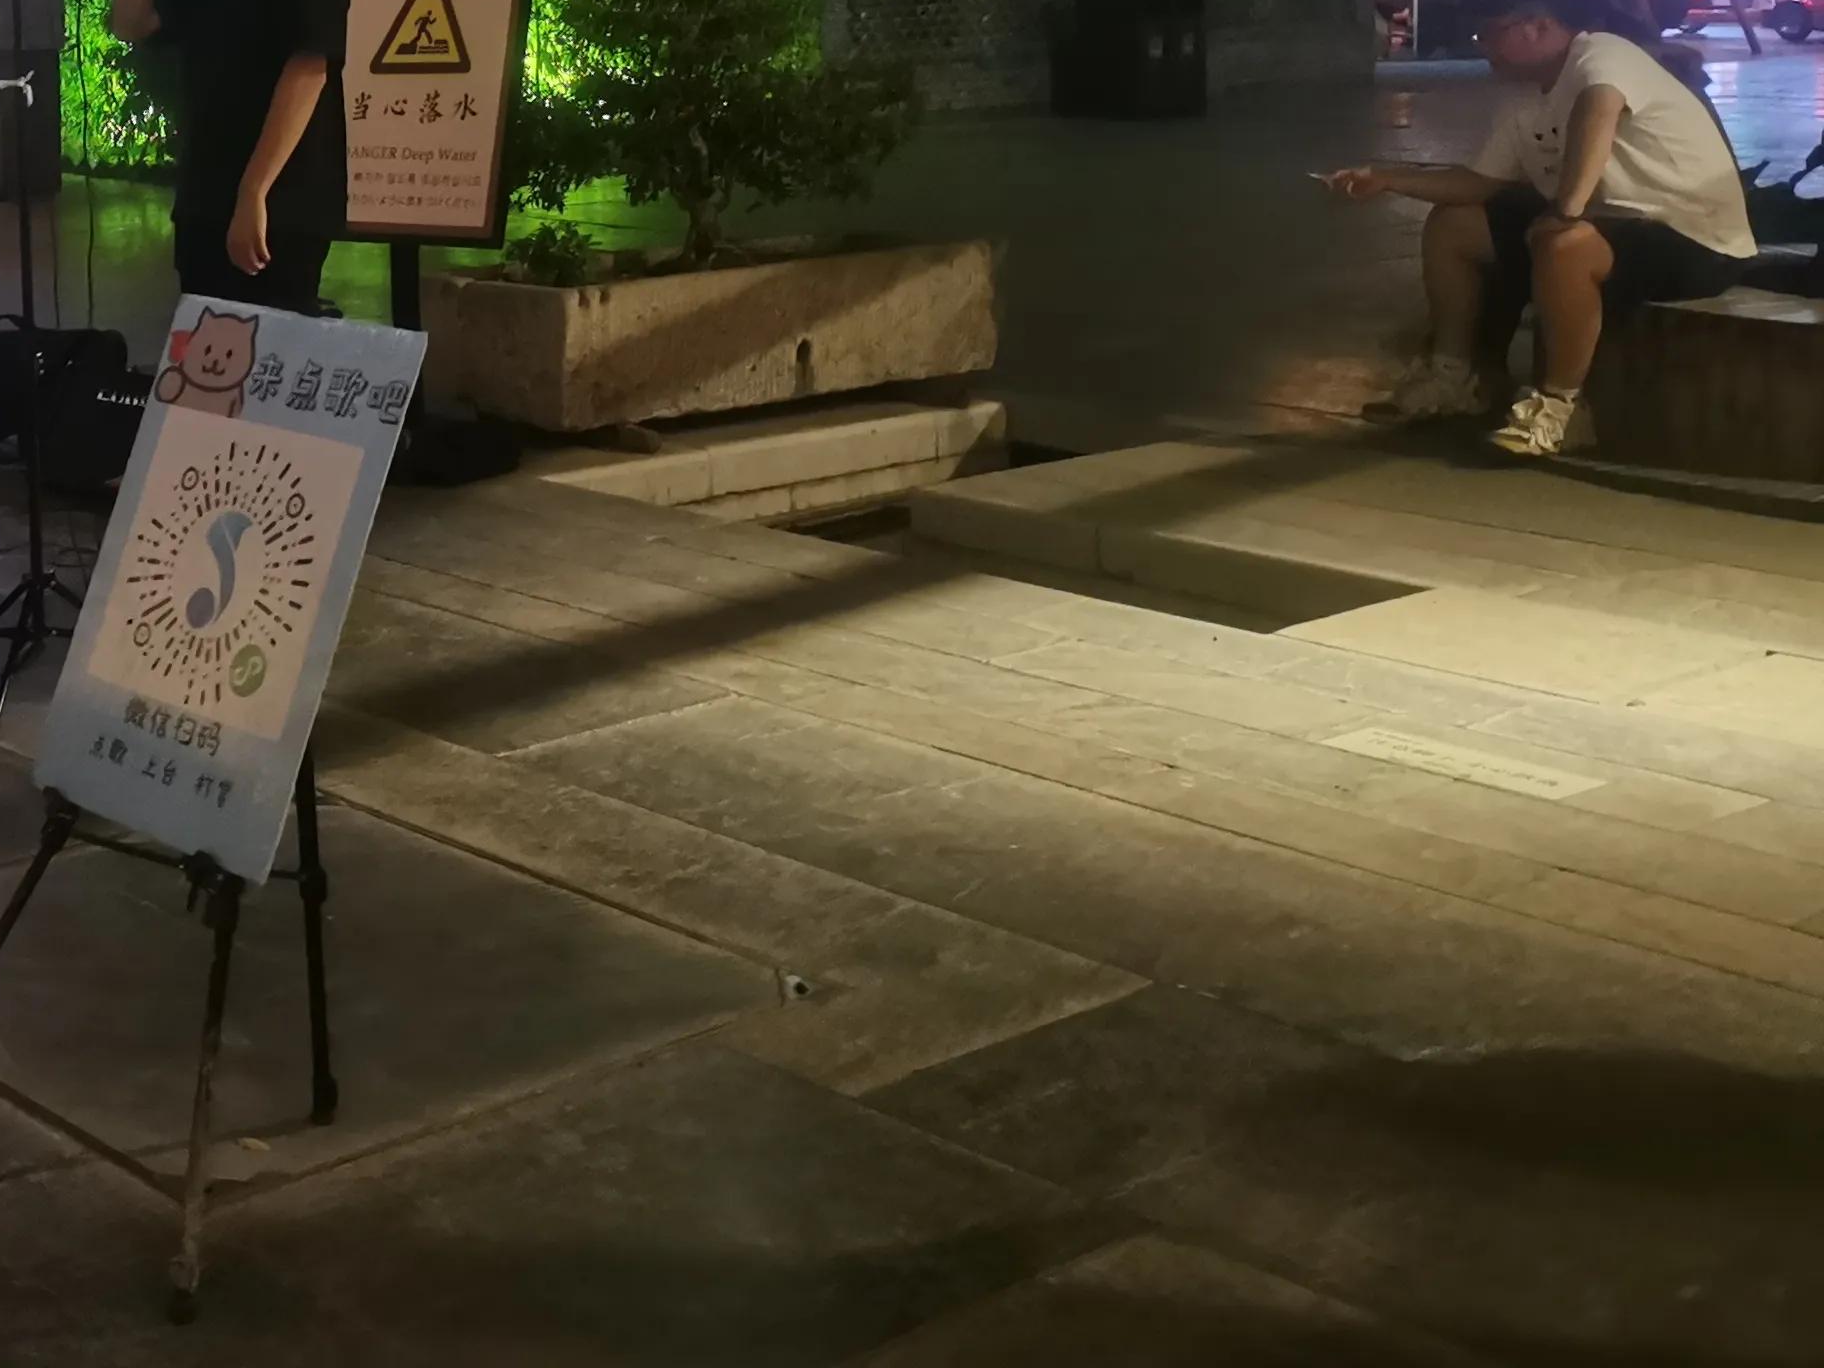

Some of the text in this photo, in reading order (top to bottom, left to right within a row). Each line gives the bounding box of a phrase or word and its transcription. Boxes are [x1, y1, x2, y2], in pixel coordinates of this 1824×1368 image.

[352, 91, 479, 124] 当心落水
[347, 145, 478, 165] ANGER Deep Water
[249, 352, 409, 425] 来点歌吧
[124, 694, 222, 756] 微信扫码
[142, 756, 177, 786] 上台
